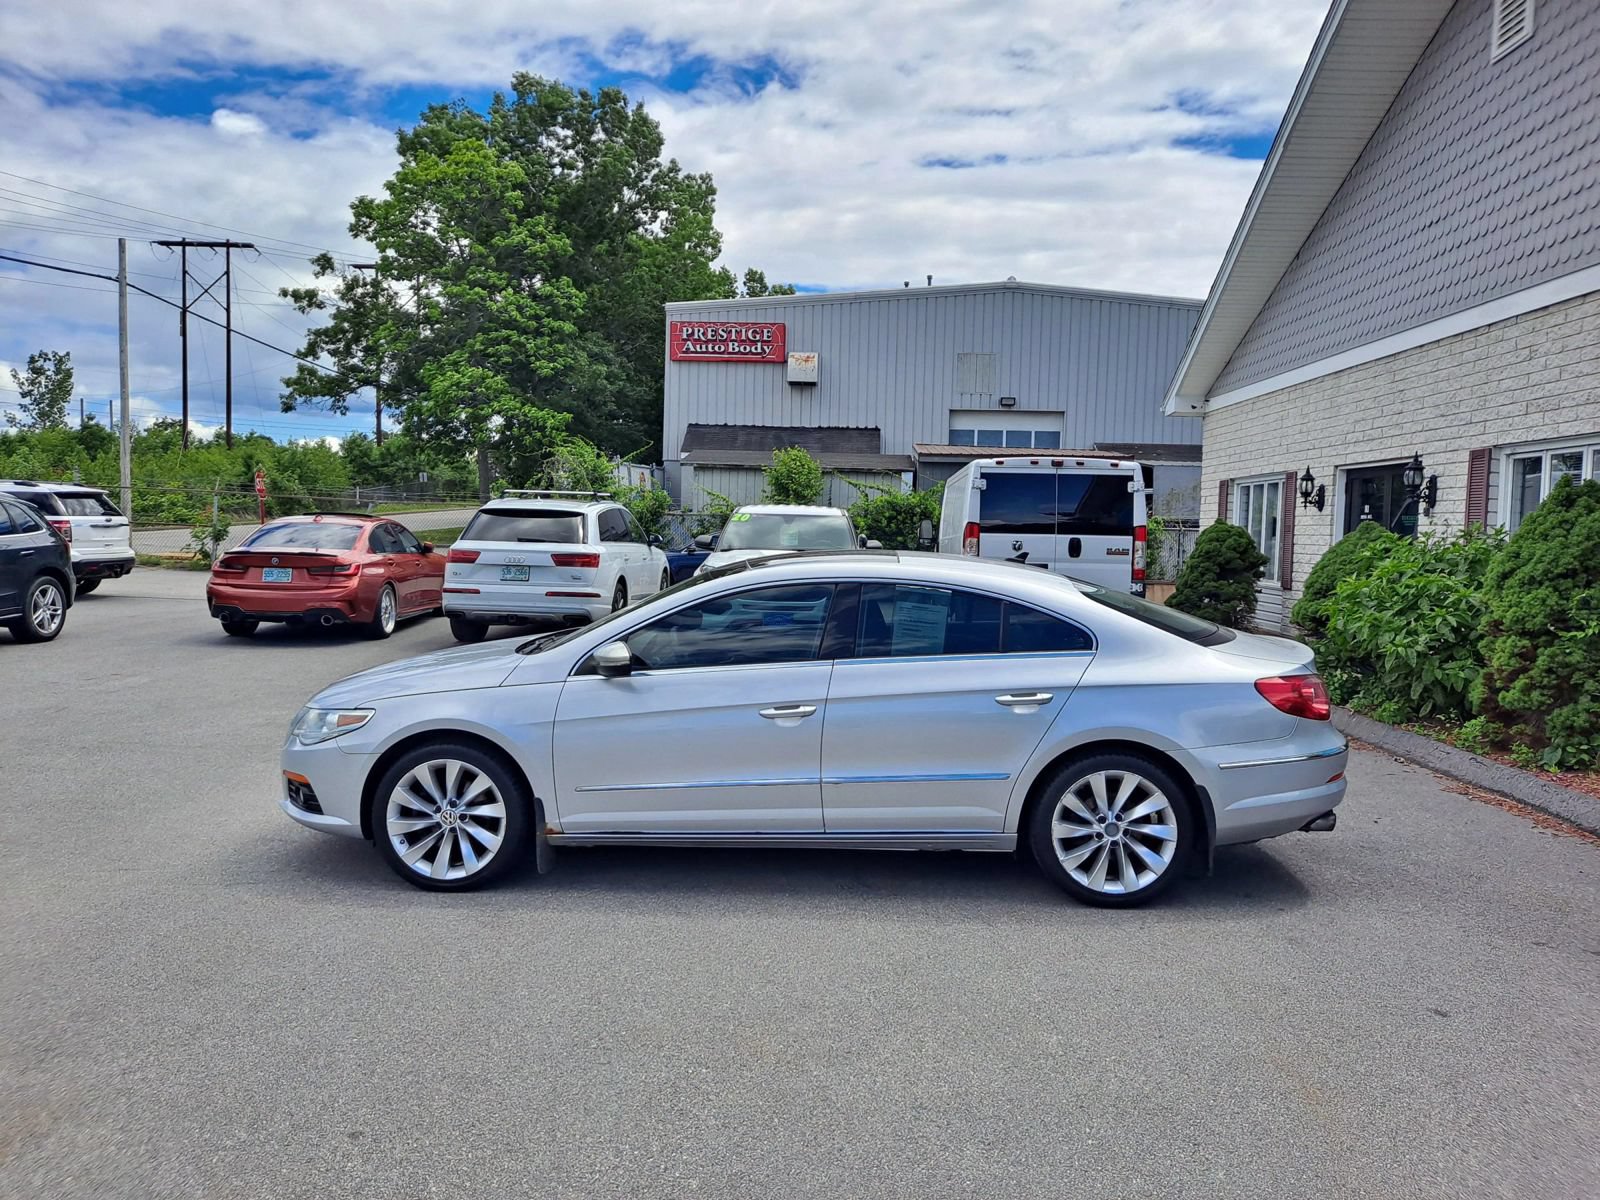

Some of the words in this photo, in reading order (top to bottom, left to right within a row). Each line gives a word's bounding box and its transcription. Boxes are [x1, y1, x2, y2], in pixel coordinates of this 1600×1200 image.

[682, 326, 773, 341] PRESTIGE
[682, 341, 725, 353] Auto
[727, 341, 773, 357] Body
[730, 513, 751, 522] 20
